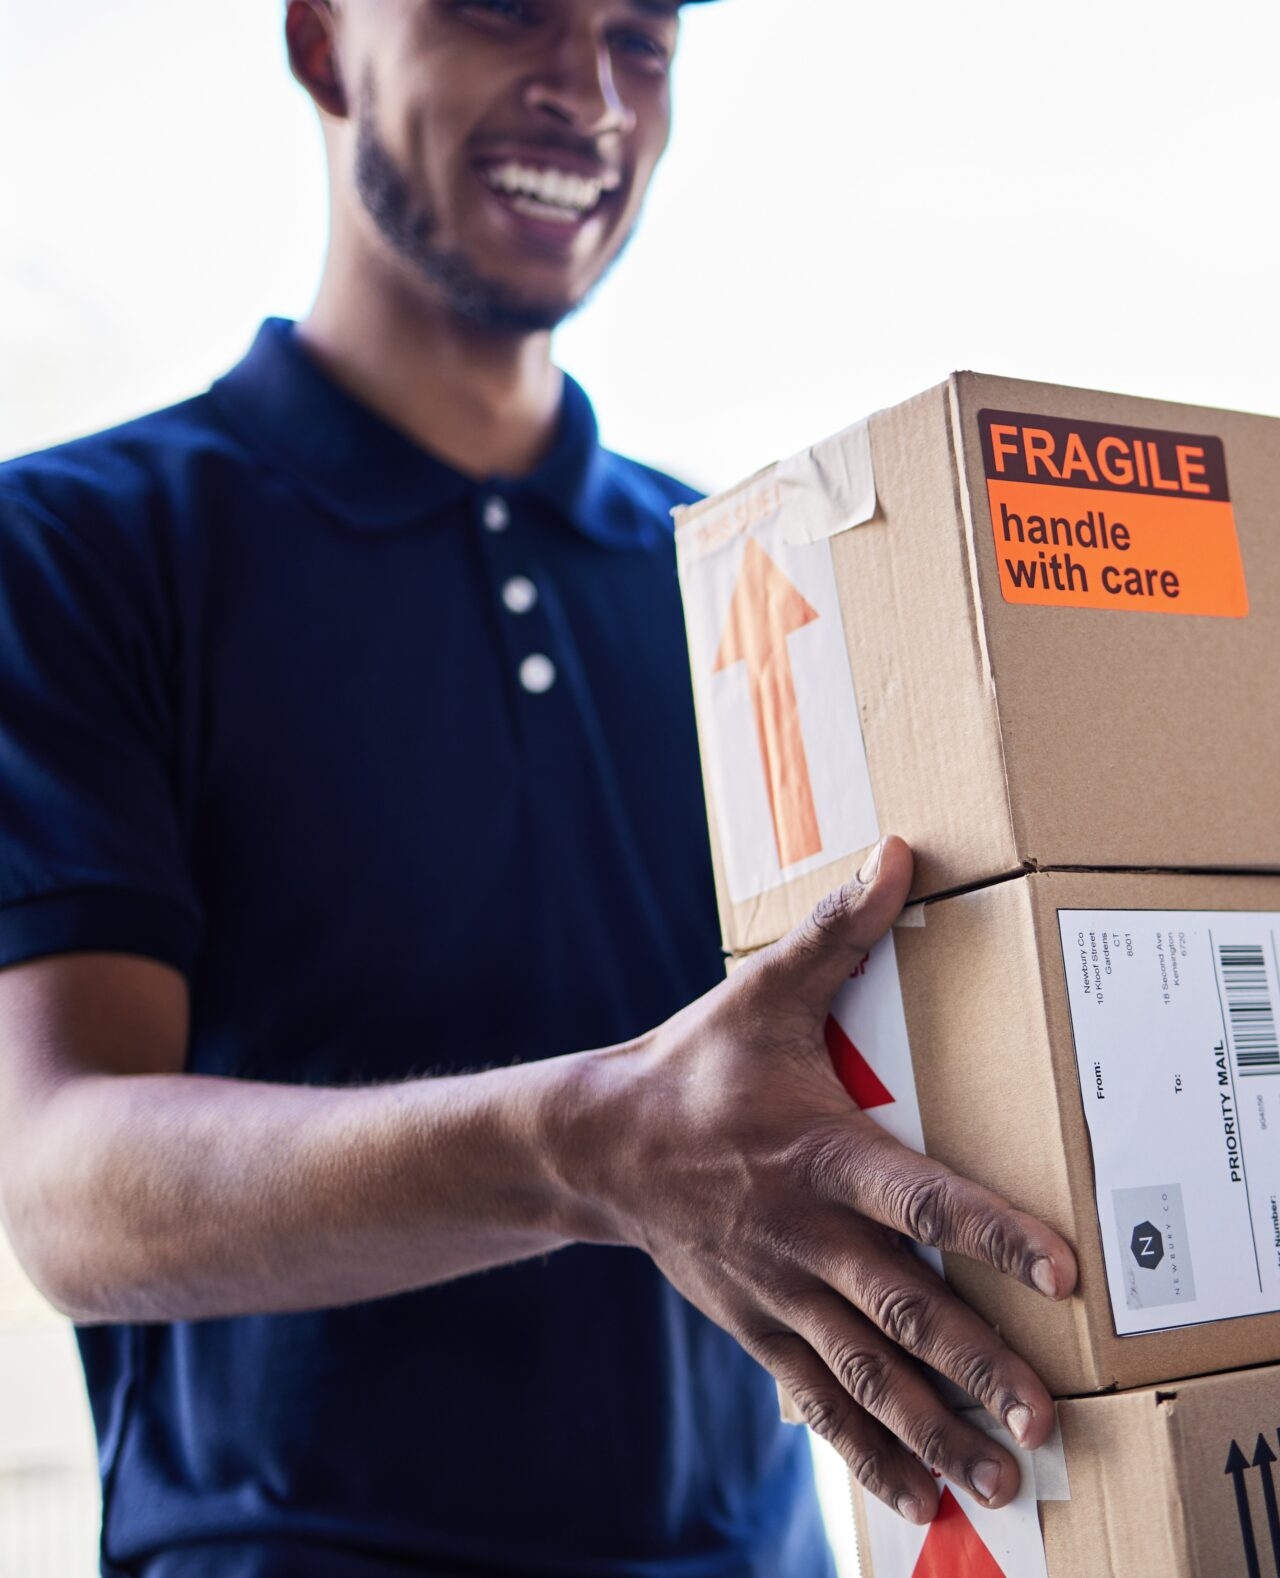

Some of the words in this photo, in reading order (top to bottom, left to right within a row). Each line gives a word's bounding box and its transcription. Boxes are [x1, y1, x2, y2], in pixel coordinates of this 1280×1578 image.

[989, 423, 1211, 494] FRAGILE
[999, 503, 1131, 551] handle
[1004, 551, 1088, 592] with
[1101, 564, 1180, 598] care
[1077, 931, 1085, 948] Co
[1088, 931, 1099, 963] Street
[1101, 931, 1113, 976] Gardens
[1111, 932, 1121, 948] CT
[1124, 932, 1135, 958] 8001
[1155, 931, 1164, 952] Ave
[1079, 949, 1092, 995] Newbury
[1092, 963, 1103, 991] Kloof
[1157, 953, 1170, 991] Second
[1167, 931, 1181, 987] Kensington
[1095, 991, 1105, 1006] 10
[1093, 1061, 1106, 1100] From:
[1213, 1039, 1229, 1087] MAIL
[1174, 1074, 1183, 1095] To:
[1219, 1092, 1242, 1183] PRIORITY
[1160, 1192, 1170, 1213] CO
[1138, 1235, 1156, 1257] N
[1165, 1223, 1182, 1297] NEWBURY
